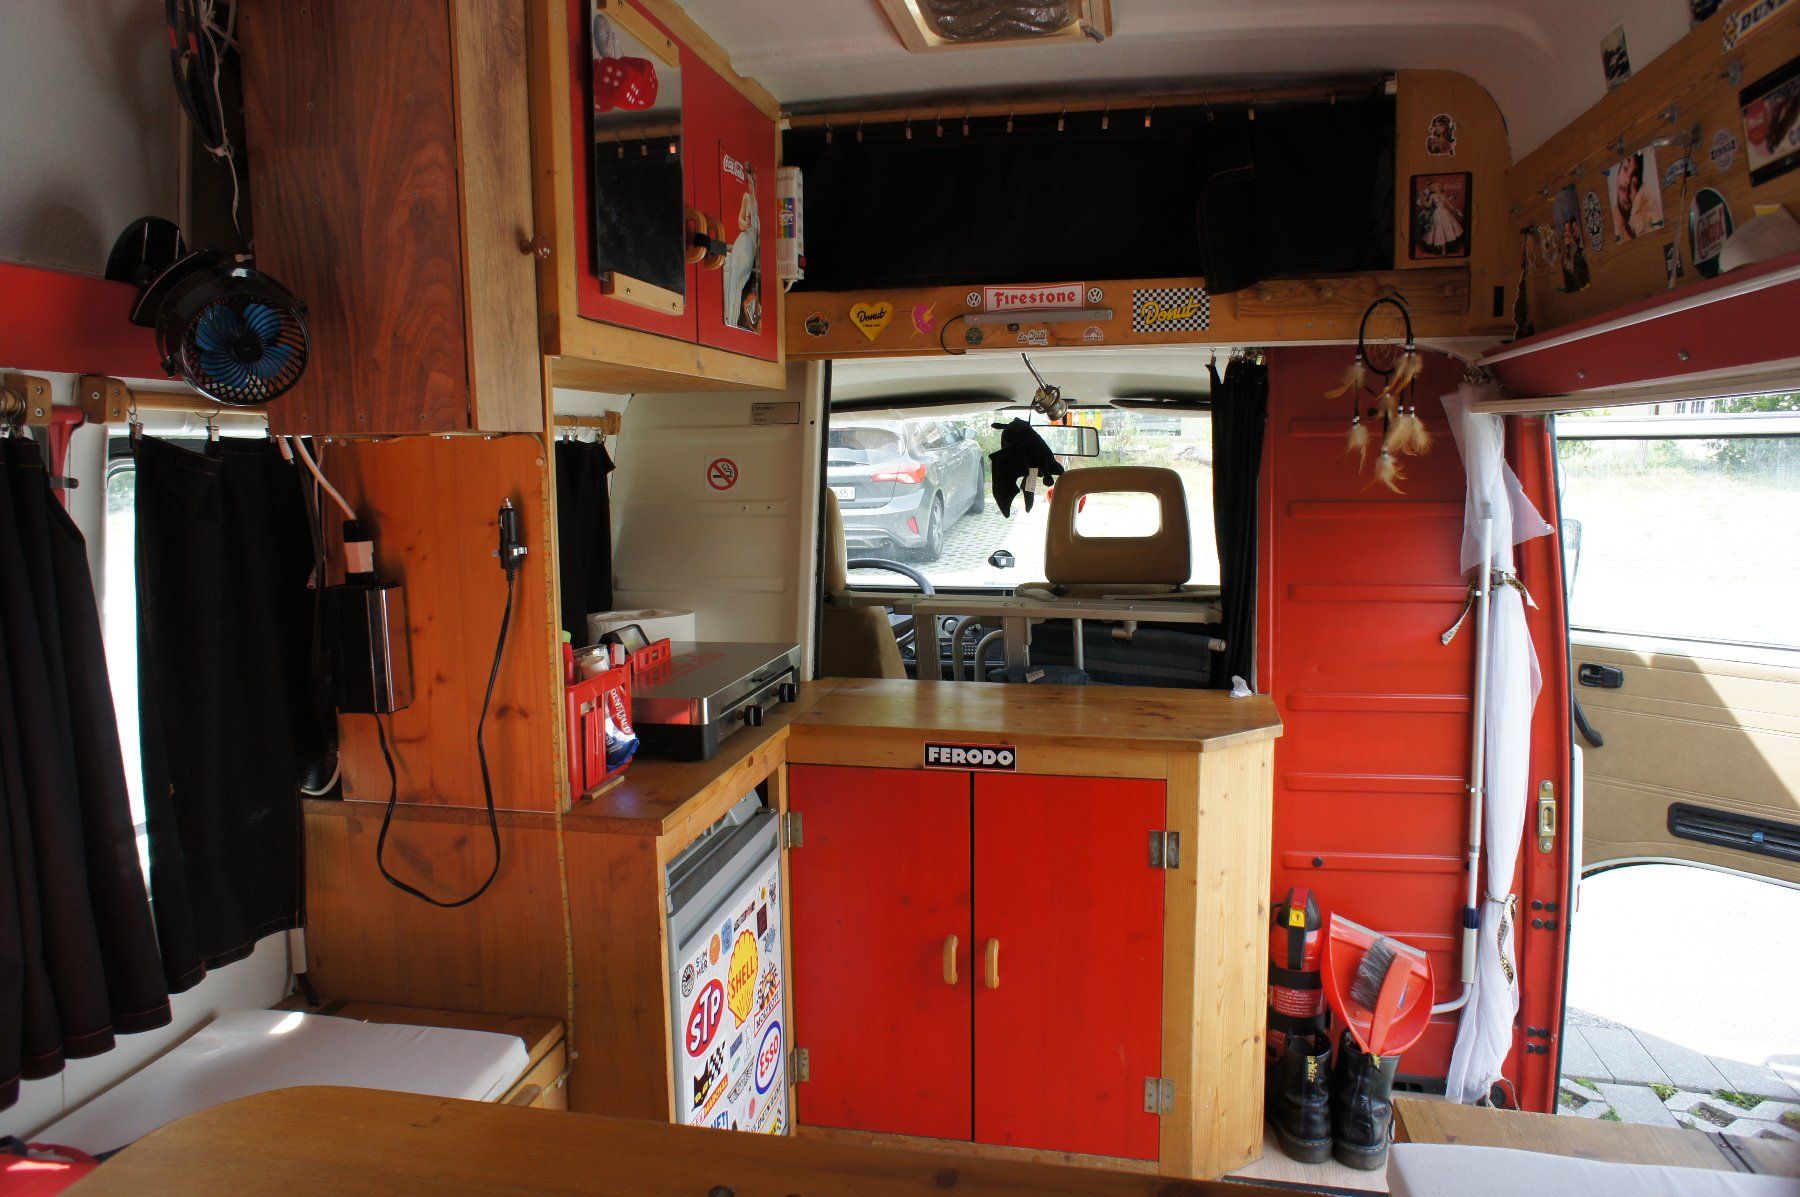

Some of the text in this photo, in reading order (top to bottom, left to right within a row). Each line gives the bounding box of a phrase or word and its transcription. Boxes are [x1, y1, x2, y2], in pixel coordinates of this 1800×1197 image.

[1741, 0, 1787, 31] DUN
[994, 291, 1075, 308] Firestone
[1141, 295, 1201, 325] Donut
[928, 747, 1014, 766] FERODO
[731, 956, 754, 999] SHELL
[691, 984, 721, 1052] STP
